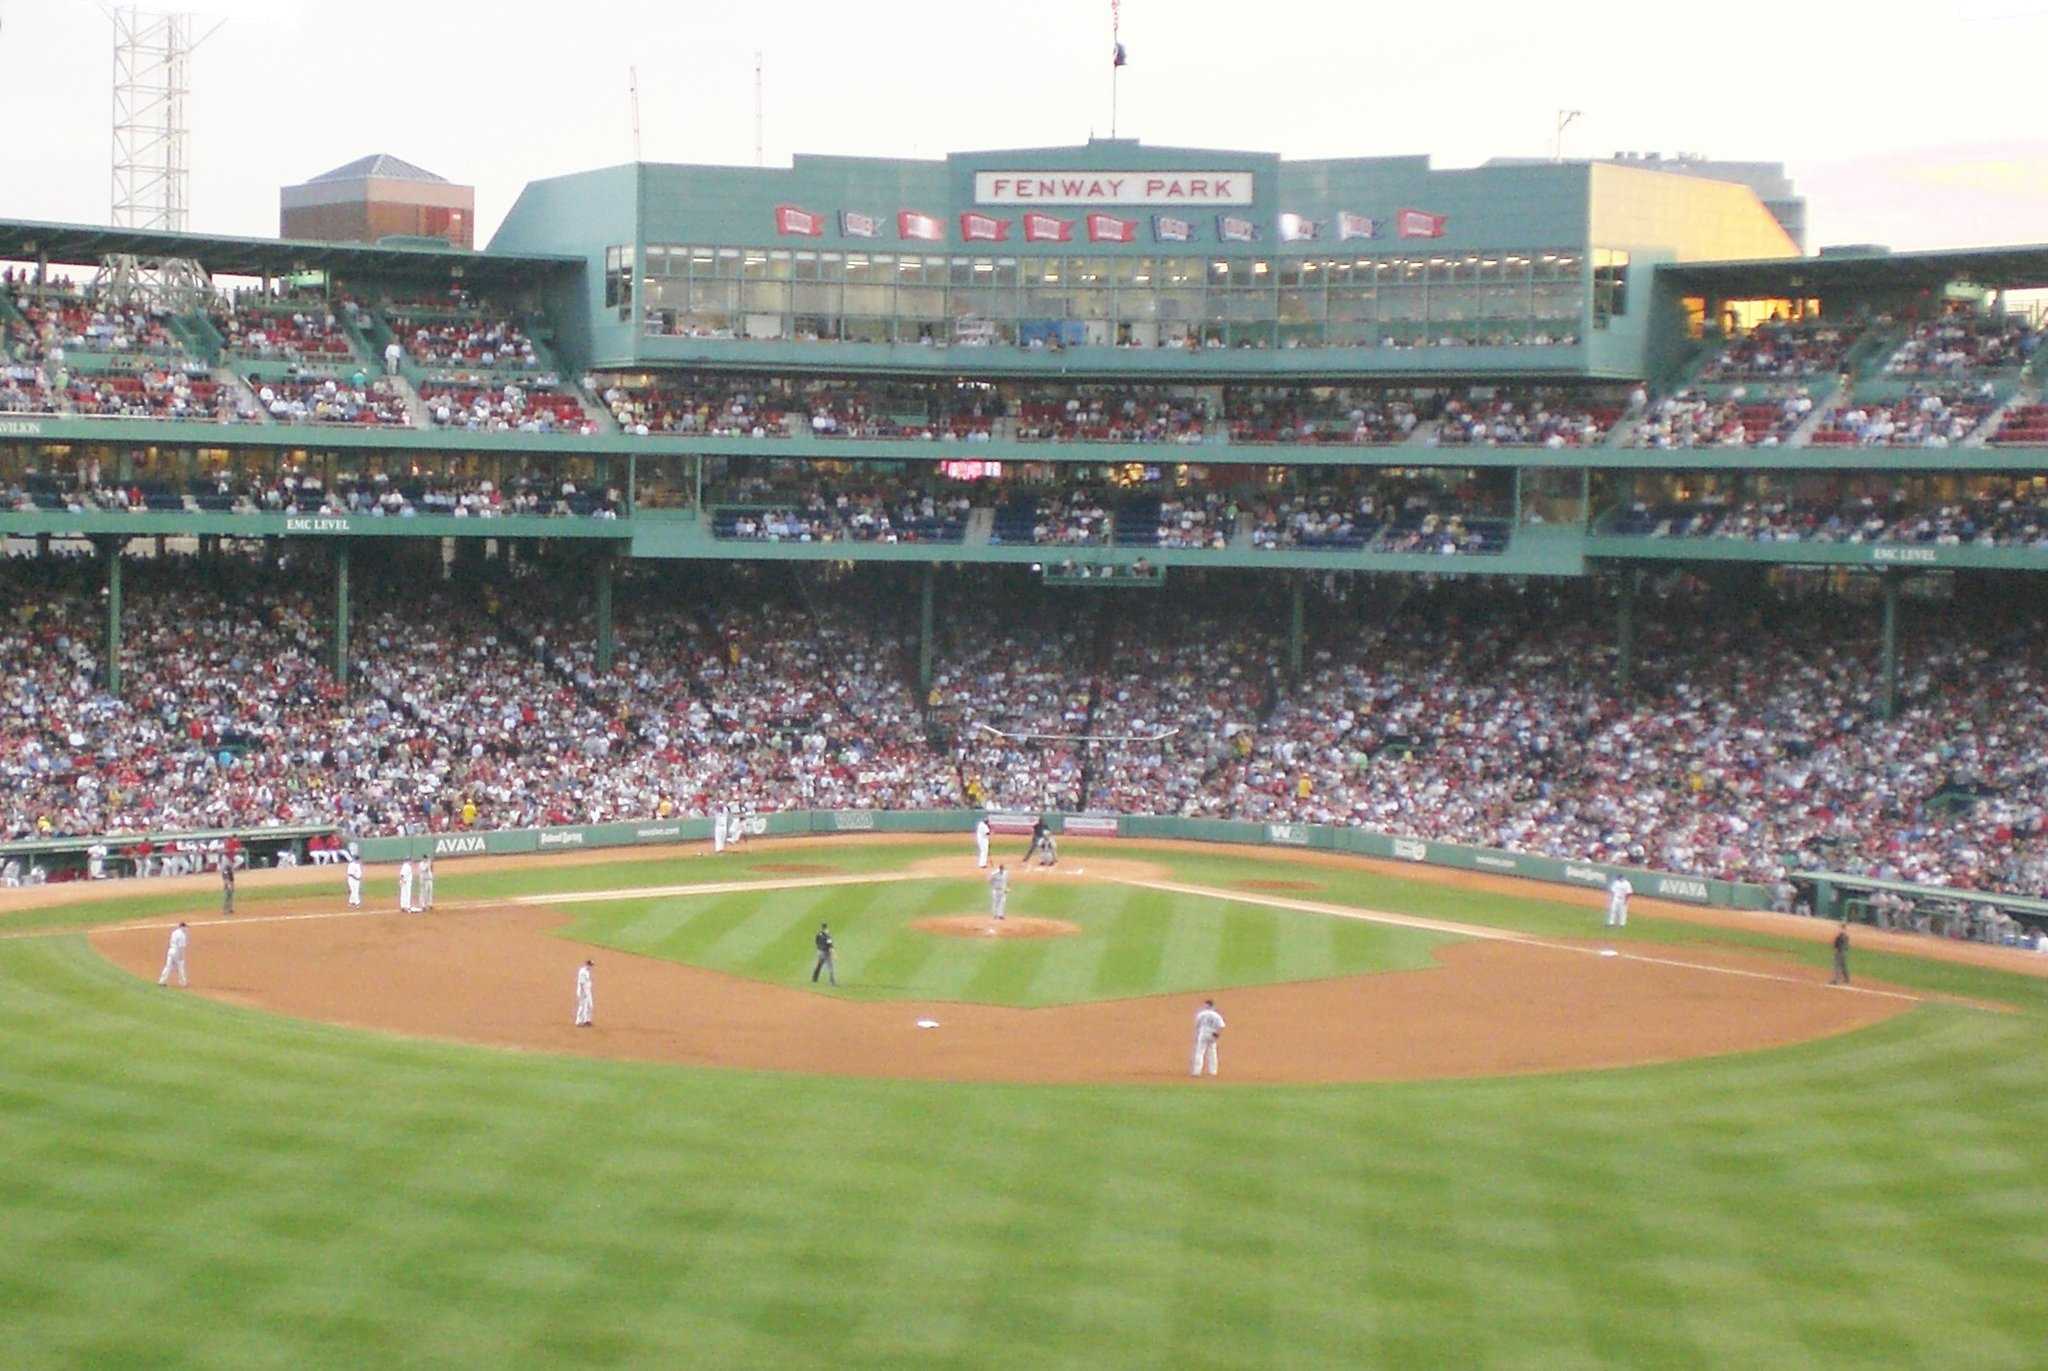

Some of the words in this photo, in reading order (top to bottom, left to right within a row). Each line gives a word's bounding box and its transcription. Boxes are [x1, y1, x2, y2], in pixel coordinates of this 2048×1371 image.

[993, 179, 1125, 198] FENWAY
[1146, 179, 1233, 198] PARK
[287, 519, 311, 530] EMC
[313, 519, 350, 530] LEVEL
[435, 836, 486, 853] AVAYA
